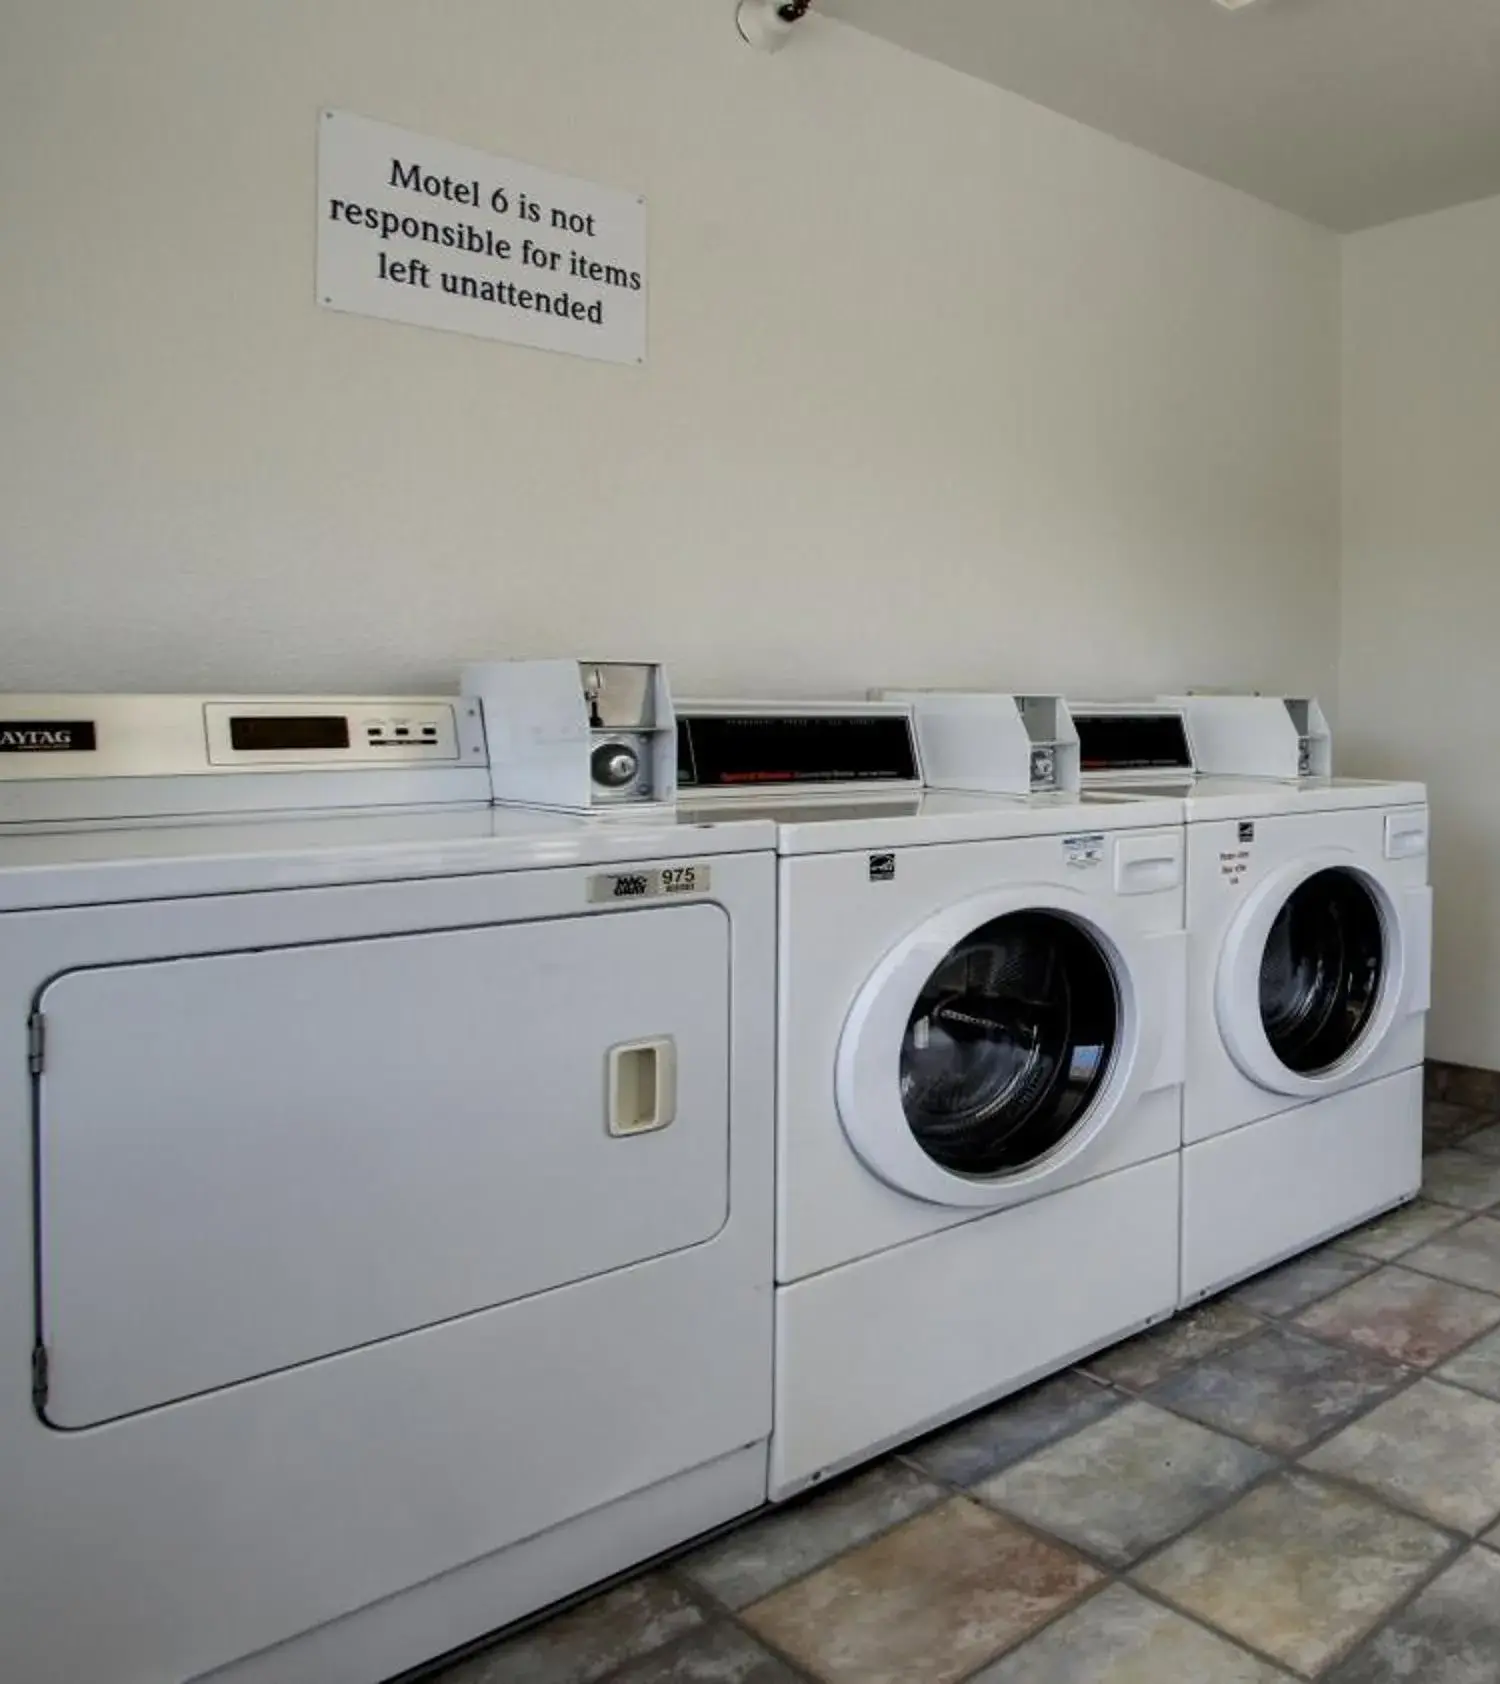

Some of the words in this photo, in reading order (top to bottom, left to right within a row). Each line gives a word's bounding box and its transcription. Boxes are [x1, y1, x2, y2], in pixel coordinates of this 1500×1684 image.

[388, 158, 480, 208] Motel
[491, 188, 509, 214] 6
[518, 193, 541, 224] is
[551, 207, 596, 237] not
[328, 198, 512, 260] responsible
[521, 240, 561, 272] for
[569, 250, 642, 291] items
[377, 252, 431, 289] left
[440, 272, 604, 325] unattended
[1, 730, 72, 745] AYTAG
[662, 867, 695, 885] 975
